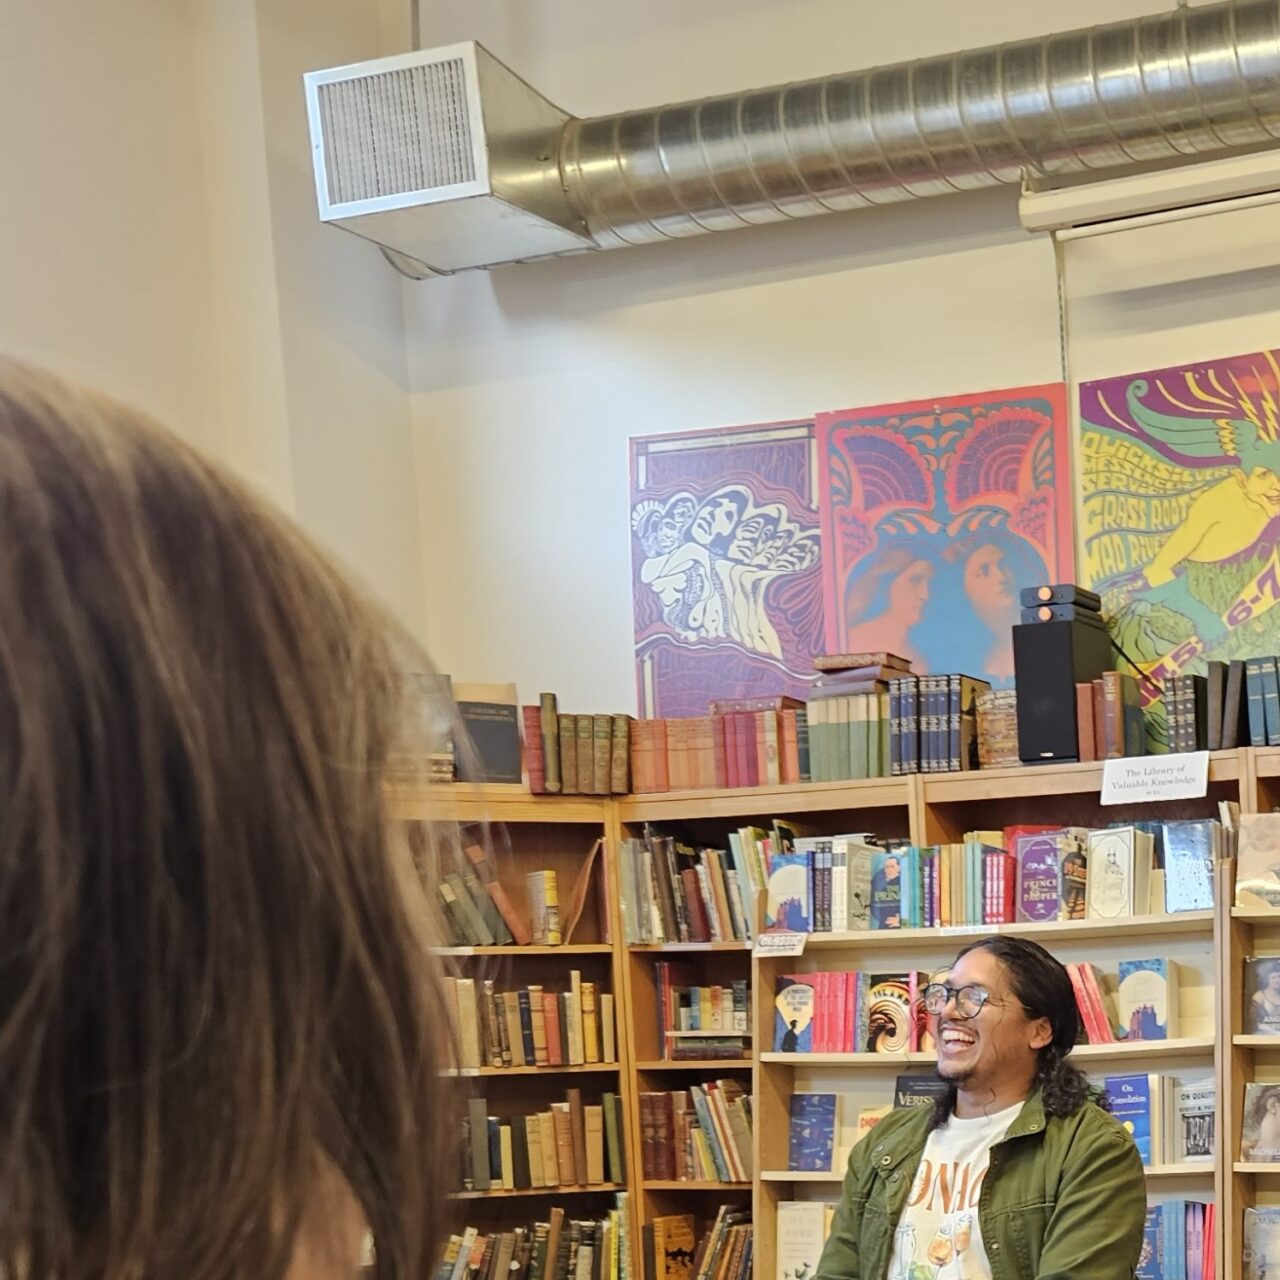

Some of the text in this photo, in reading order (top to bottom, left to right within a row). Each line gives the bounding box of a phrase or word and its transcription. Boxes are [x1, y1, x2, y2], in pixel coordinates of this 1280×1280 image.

[1082, 431, 1230, 482] QUICKSILVER
[1083, 494, 1148, 533] GRASS
[1086, 533, 1128, 585] MAD
[1126, 764, 1186, 777] The Library of
[1111, 776, 1197, 789] Valuable Knowledge
[873, 989, 909, 1006] ISLAND
[1121, 1084, 1134, 1093] On
[1180, 1093, 1191, 1101] ON
